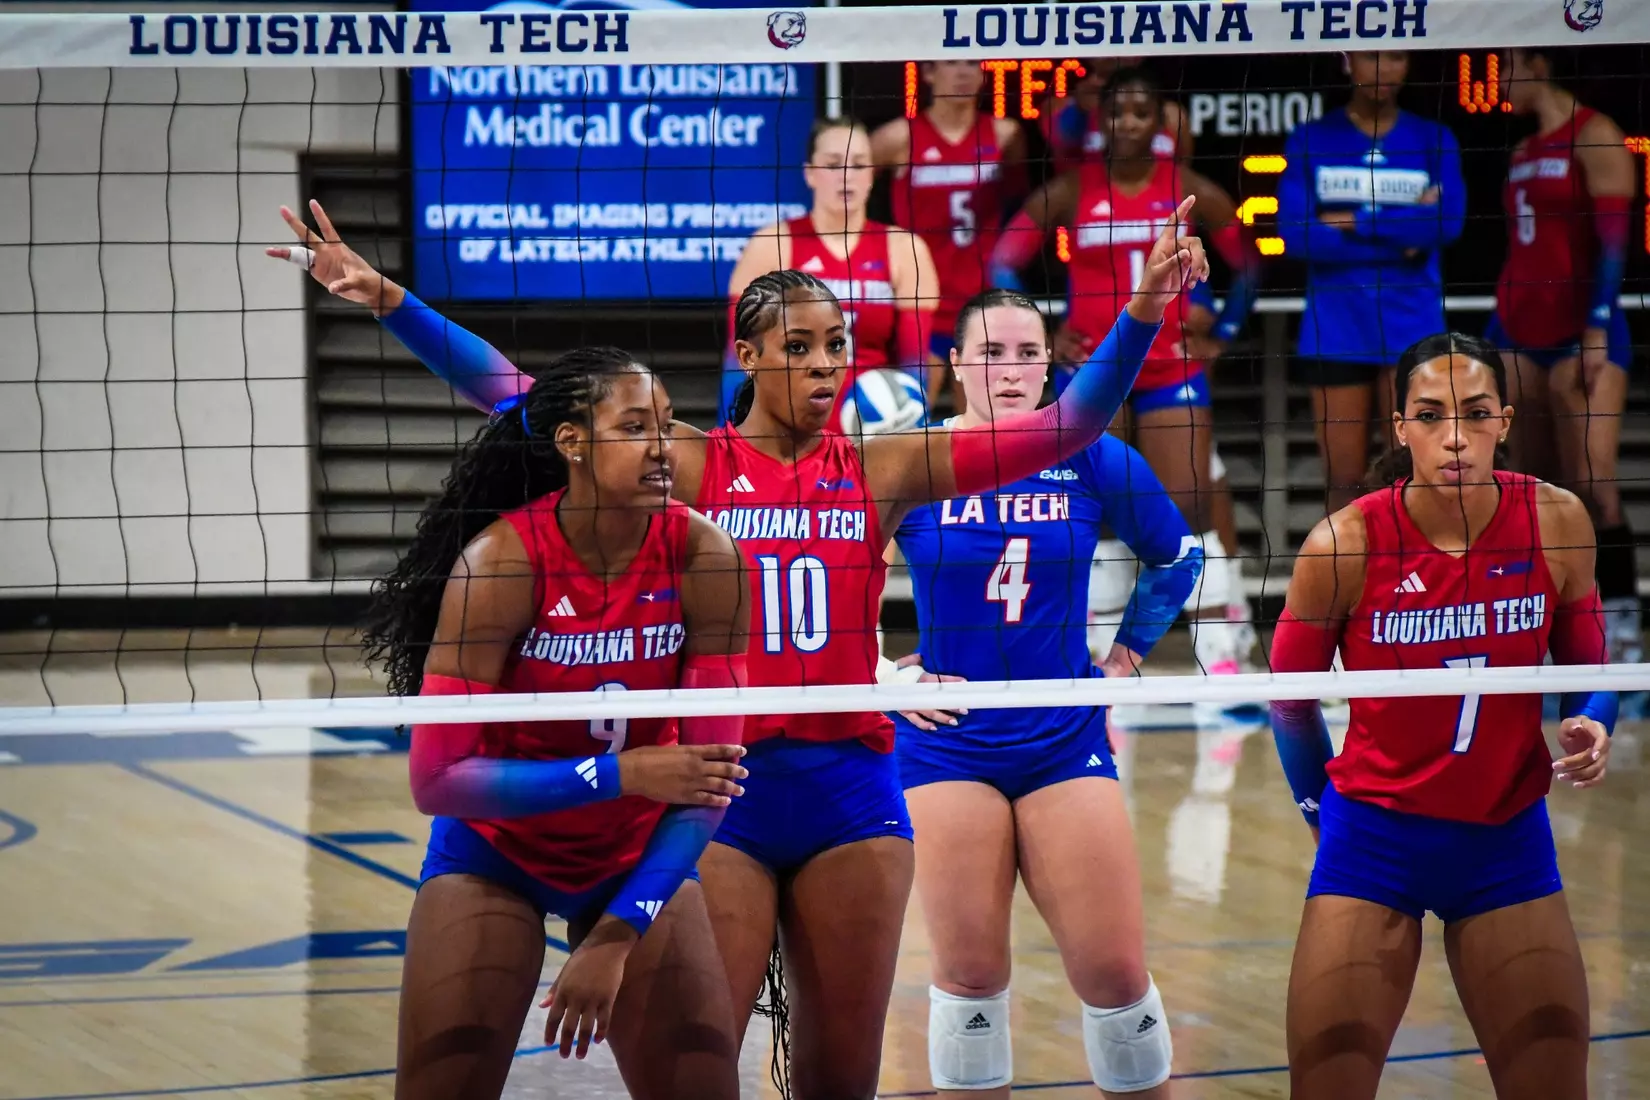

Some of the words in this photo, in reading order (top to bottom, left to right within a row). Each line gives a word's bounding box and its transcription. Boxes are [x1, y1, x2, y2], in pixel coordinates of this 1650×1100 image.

[129, 14, 451, 55] LOUISIANA
[479, 13, 629, 53] TECH
[942, 3, 1253, 48] LOUISIANA
[1281, 0, 1427, 40] TECH
[430, 65, 608, 96] Northern
[619, 64, 798, 95] Louisiana
[981, 60, 1087, 119] TEC
[463, 104, 620, 146] Medical
[629, 105, 765, 146] Center
[425, 204, 548, 230] OFFICIAL
[553, 204, 667, 229] IMAGING
[949, 190, 975, 247] 5
[459, 237, 495, 263] OF
[818, 508, 866, 542] TECH
[941, 495, 984, 525] LA
[995, 493, 1069, 523] TECH
[984, 537, 1032, 623] 4
[755, 555, 829, 653] 10
[1372, 602, 1487, 644] LOUISIANA
[1493, 594, 1546, 634] TECH
[520, 627, 634, 666] LOUISIANA
[642, 623, 685, 660] TEC
[1443, 656, 1487, 753] 7
[965, 1021, 991, 1030] adidas
